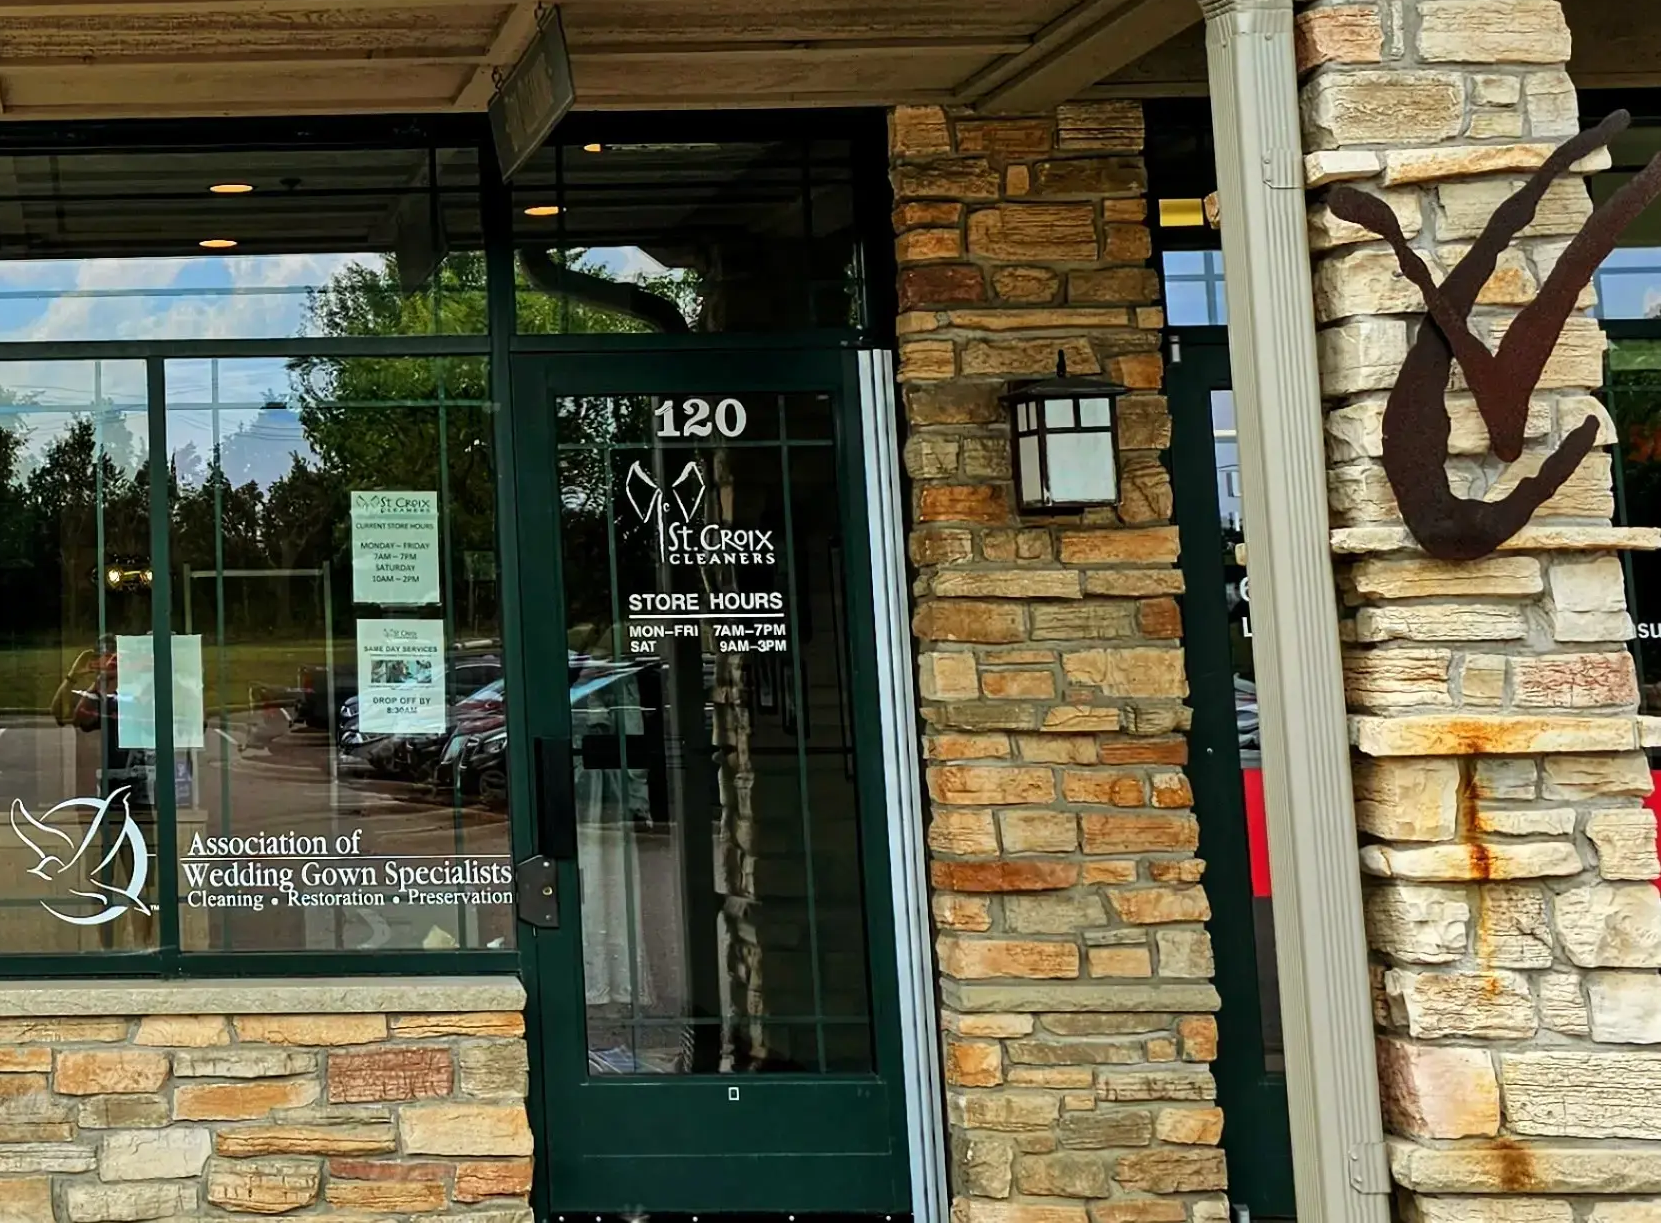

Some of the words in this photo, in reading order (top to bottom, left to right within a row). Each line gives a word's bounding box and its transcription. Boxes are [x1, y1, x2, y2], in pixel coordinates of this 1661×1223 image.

[654, 398, 747, 438] 120
[668, 521, 698, 552] St.
[669, 553, 776, 565] CLEANERS
[629, 593, 700, 611] STORE
[710, 592, 783, 610] HOURS
[630, 640, 657, 653] SAT
[373, 697, 397, 705] DROP
[399, 697, 417, 705] OFF
[419, 697, 431, 705] BY
[187, 831, 329, 856] Association
[335, 829, 363, 855] of
[182, 862, 293, 892] Wedding
[301, 861, 377, 887] Gown
[385, 859, 513, 892] Specialists
[187, 889, 264, 910] Cleaning
[287, 890, 385, 907] Restoration
[407, 888, 513, 906] Preservation
